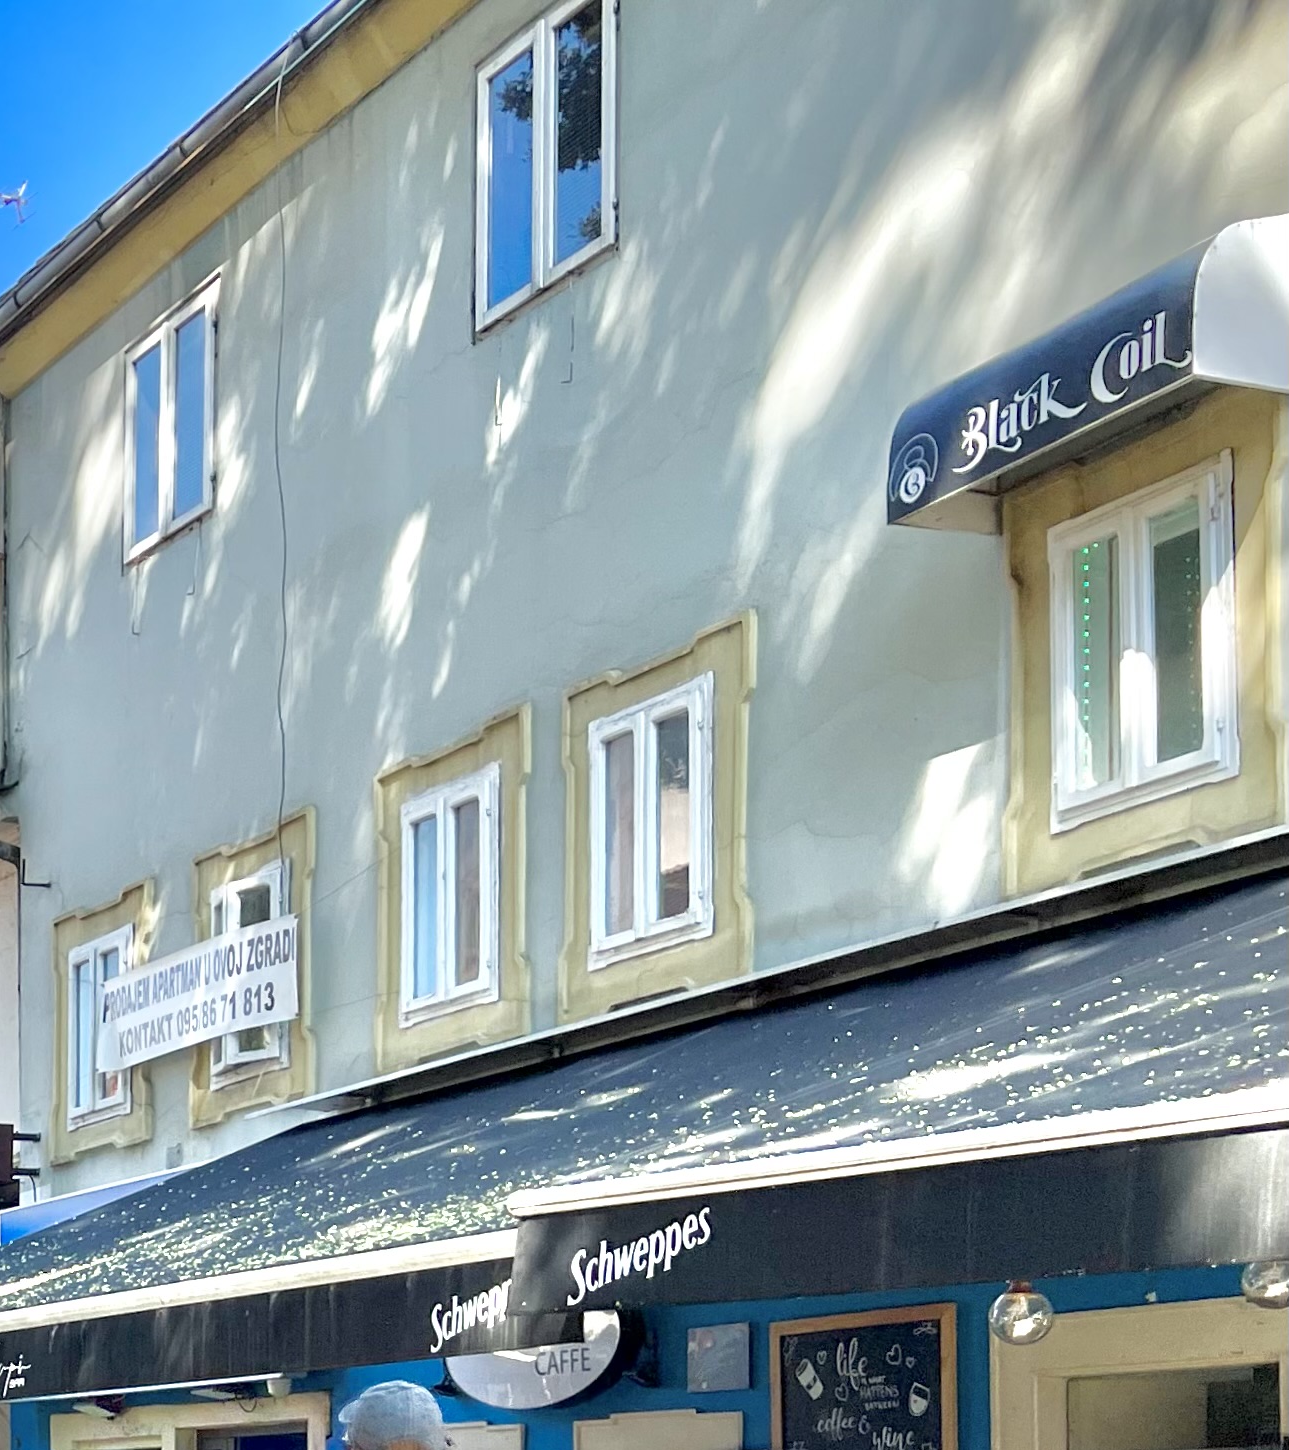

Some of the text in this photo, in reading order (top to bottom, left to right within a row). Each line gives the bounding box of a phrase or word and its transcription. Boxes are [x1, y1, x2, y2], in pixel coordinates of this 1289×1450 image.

[951, 311, 1193, 474] Black Coil
[102, 926, 296, 1024] PRODAJEM APARTMAN U OVOJ ZGRADI
[118, 1011, 174, 1058] KONTAKT
[242, 981, 276, 1017] 813
[566, 1206, 712, 1307] Schweppes
[534, 1347, 592, 1377] CAFFE
[835, 1337, 869, 1392] life
[815, 1407, 856, 1441] coffee
